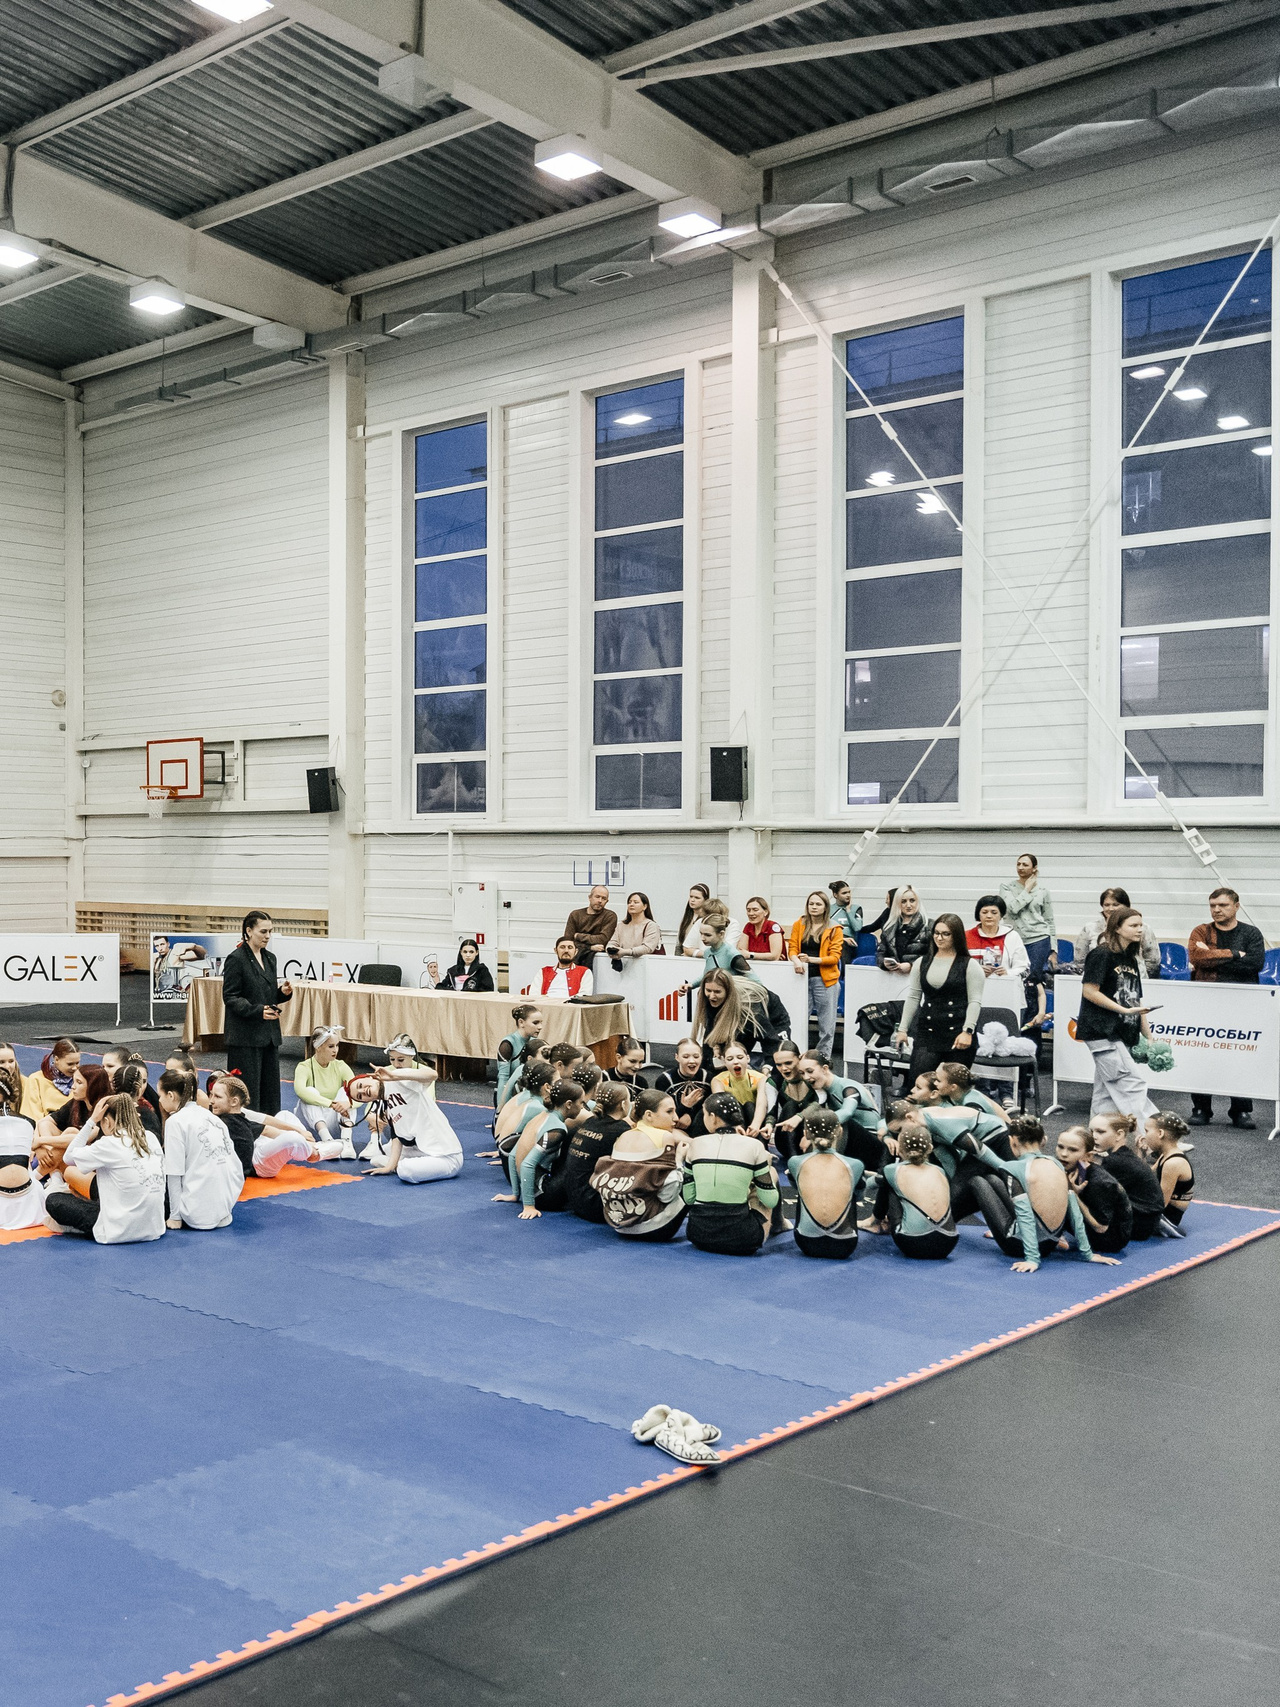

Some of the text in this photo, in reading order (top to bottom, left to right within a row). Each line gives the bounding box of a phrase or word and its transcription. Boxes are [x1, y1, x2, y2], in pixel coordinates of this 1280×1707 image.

[3, 955, 98, 982] GALEX
[1174, 1039, 1210, 1049] ЖИЗНЬ
[1213, 1041, 1258, 1052] СВЕТОМ!
